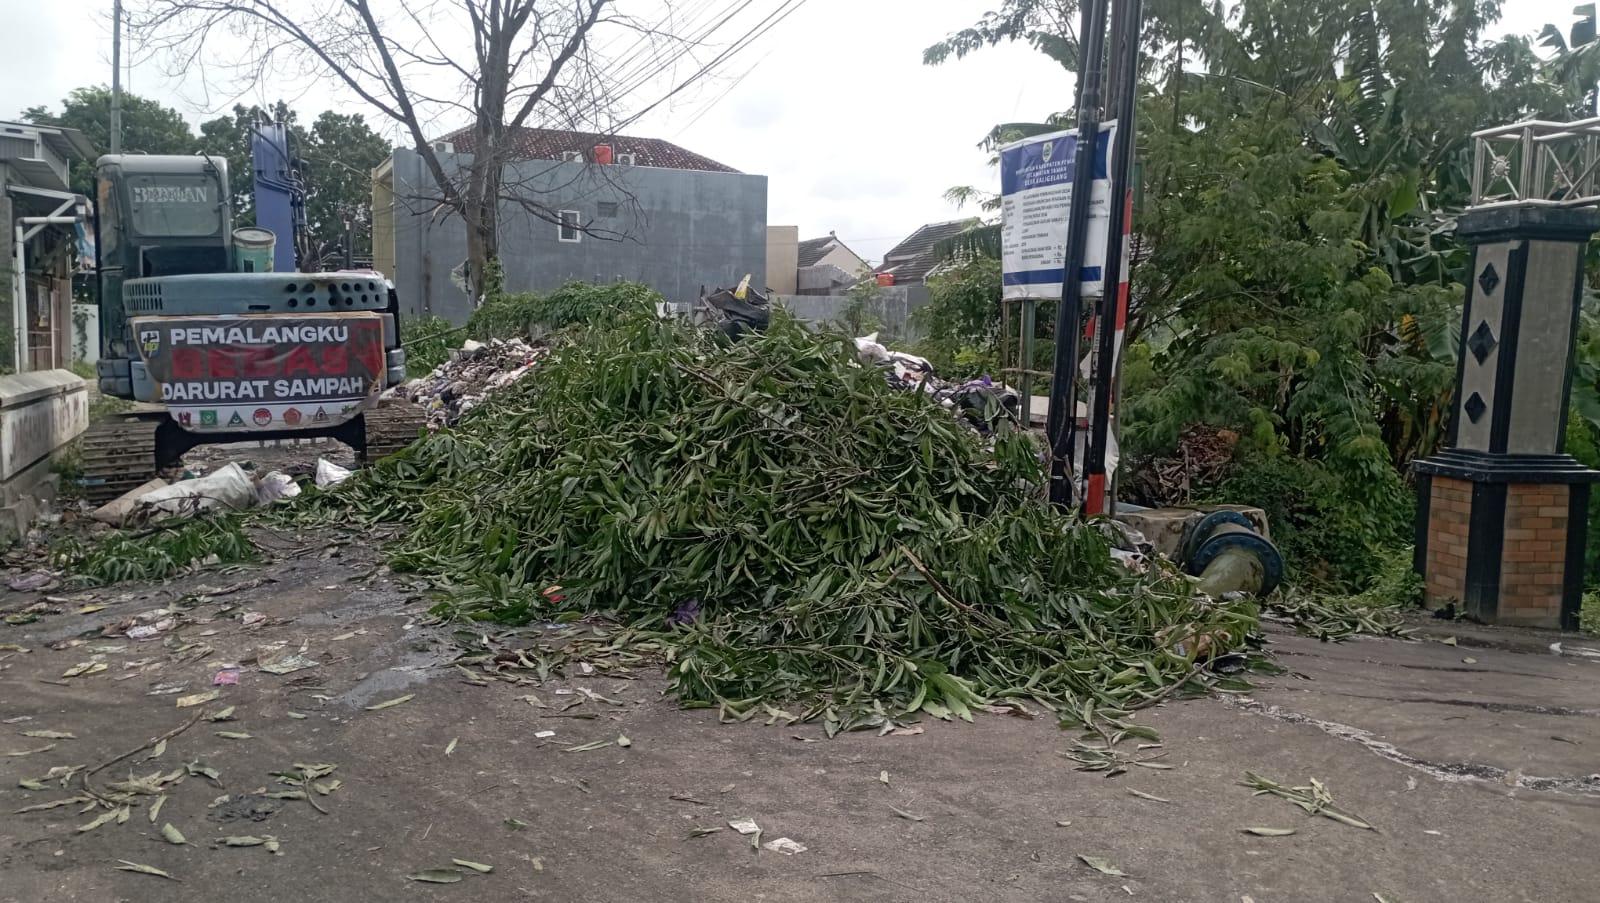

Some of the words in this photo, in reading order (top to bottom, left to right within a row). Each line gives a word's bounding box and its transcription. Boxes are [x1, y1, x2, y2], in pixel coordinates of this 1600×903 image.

[170, 326, 349, 345] PEMALANGKU
[162, 380, 269, 401] DARURAT
[274, 376, 363, 398] SAMPAH
